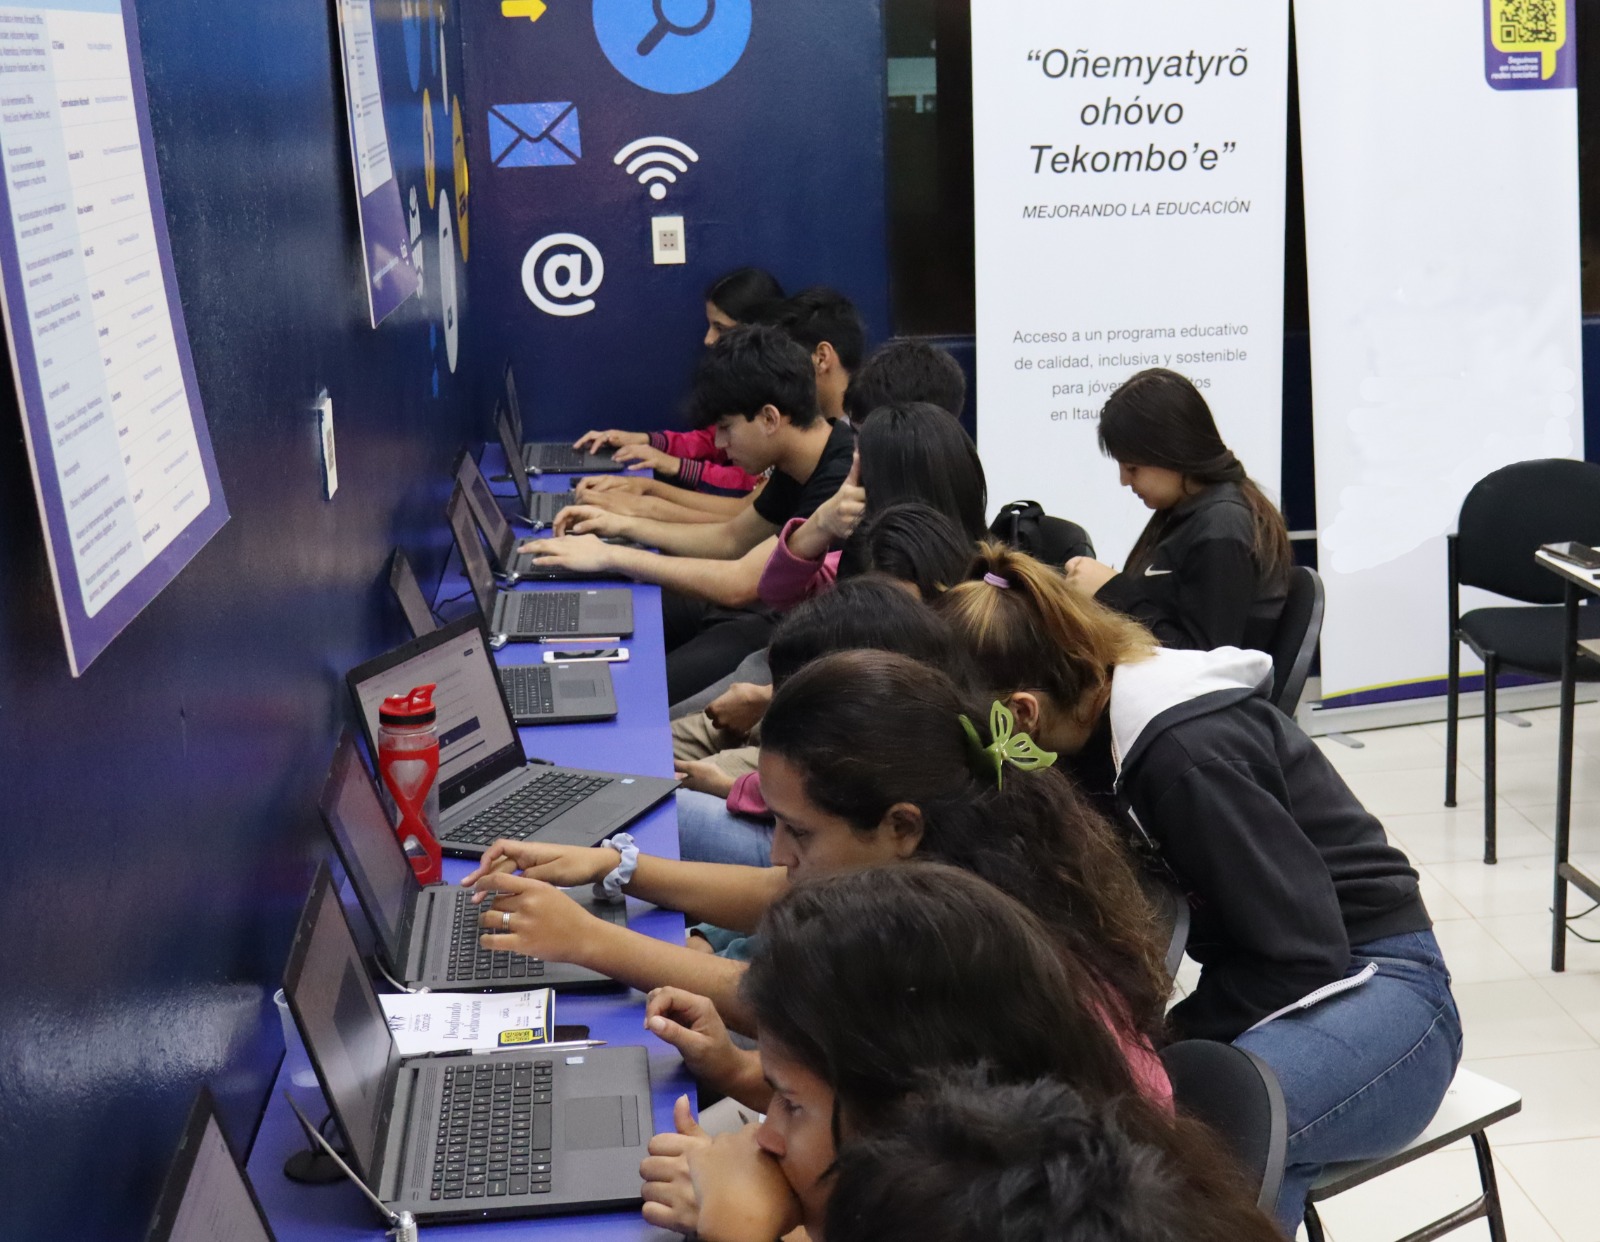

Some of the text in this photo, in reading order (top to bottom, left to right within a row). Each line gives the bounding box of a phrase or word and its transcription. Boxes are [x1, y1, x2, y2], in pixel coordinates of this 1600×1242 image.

[1027, 48, 1249, 85] “Oñemyatyrõ
[1080, 95, 1184, 126] ohóvo
[1030, 142, 1237, 174] Tekombo’e”
[1022, 197, 1251, 219] MEJORANDO LA EDUCACIÓN
[1012, 323, 1249, 344] Acceso a un programa educativo
[1014, 348, 1247, 370] de calidad, inclusiva y sostenible
[1052, 383, 1084, 397] para
[1050, 410, 1068, 421] en
